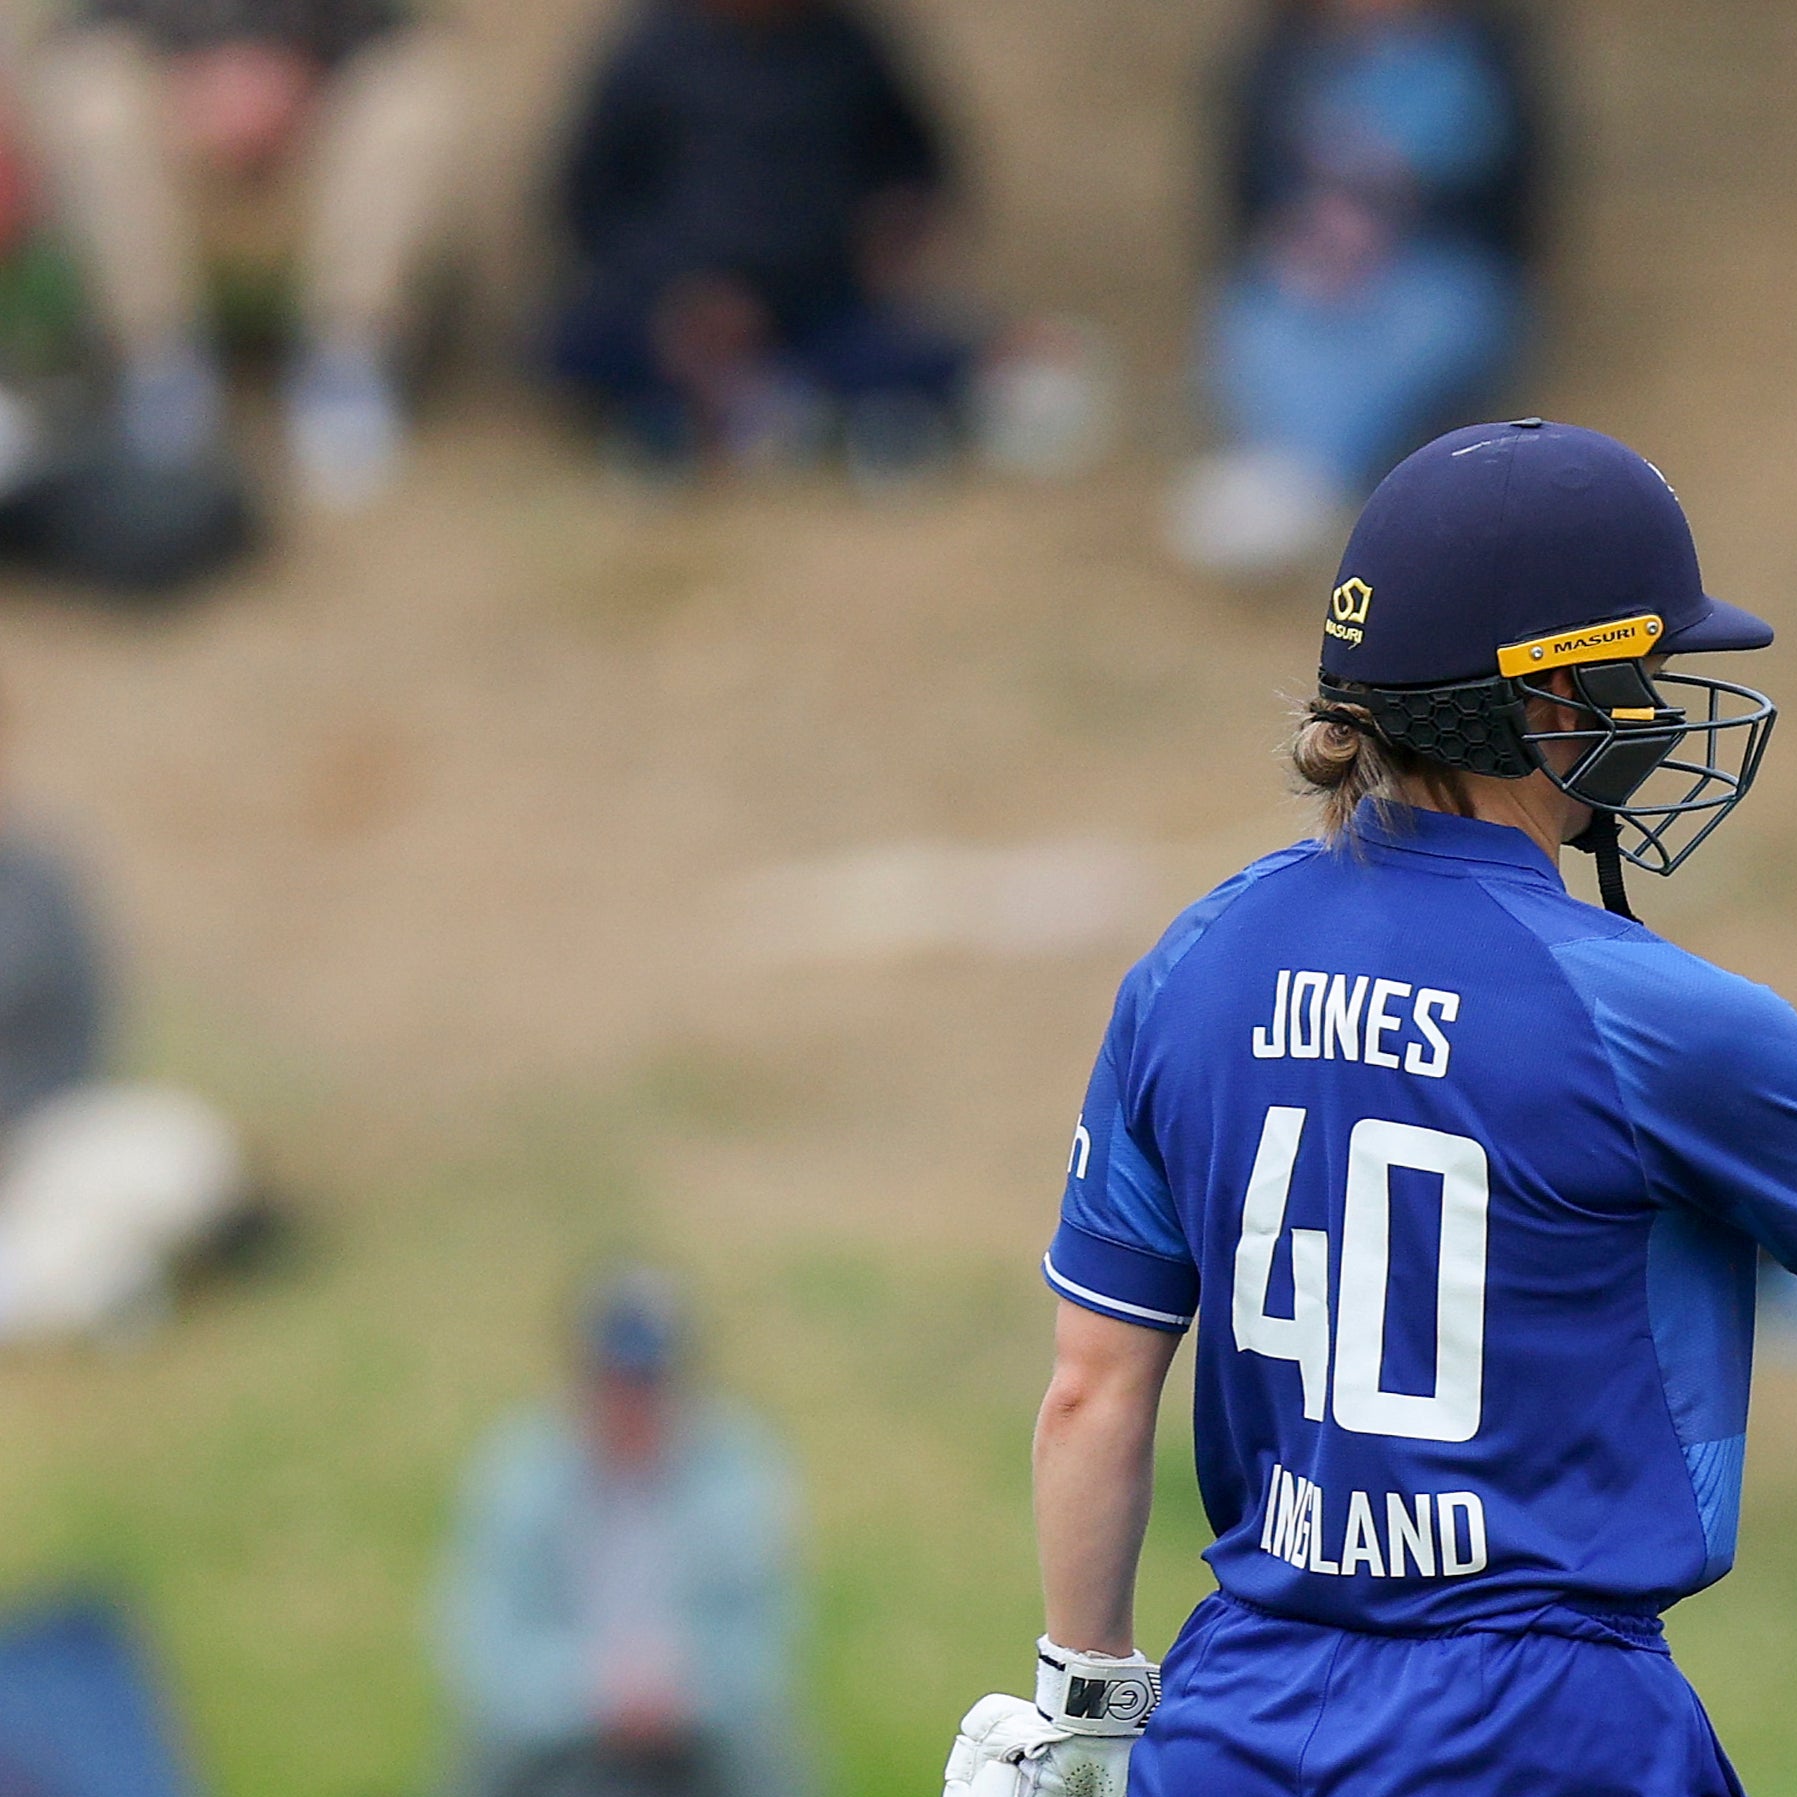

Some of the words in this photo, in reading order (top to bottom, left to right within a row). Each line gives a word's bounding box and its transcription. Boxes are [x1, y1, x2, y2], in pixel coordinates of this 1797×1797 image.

[1554, 627, 1635, 654] MASURI
[1252, 970, 1460, 1079] JONES
[1232, 1105, 1489, 1442] 40
